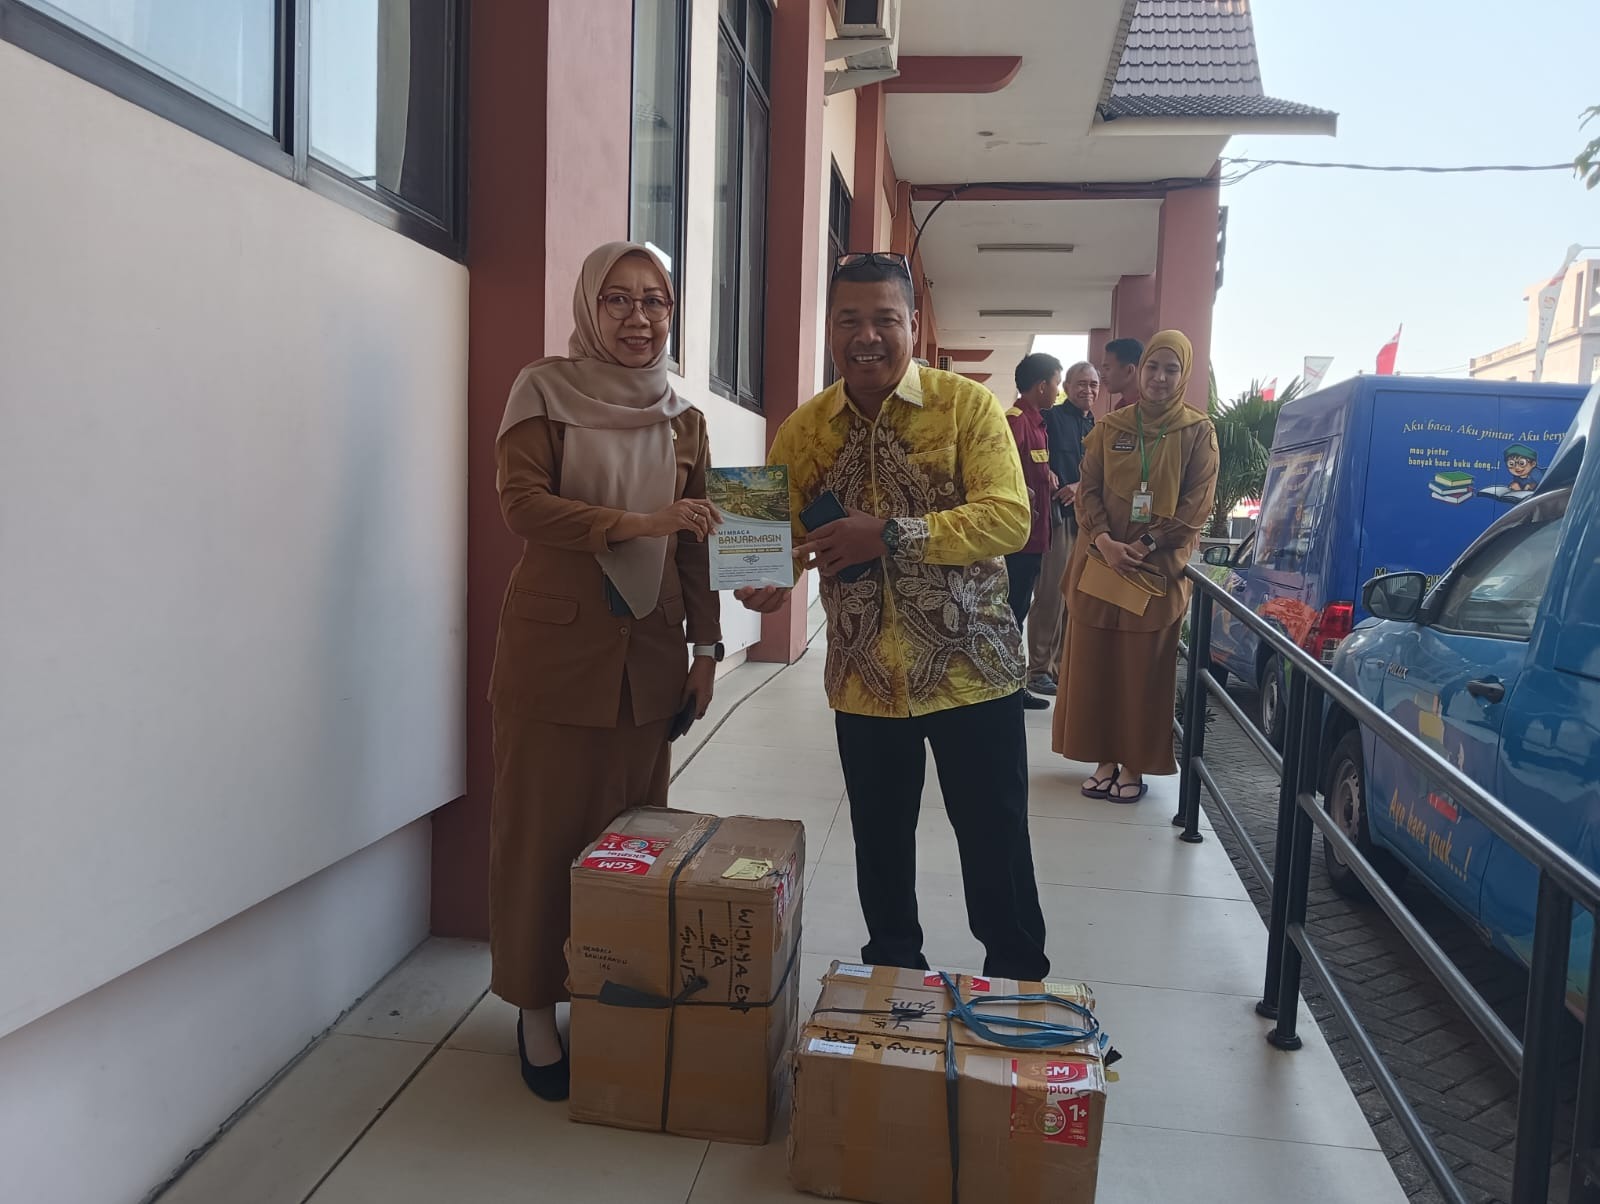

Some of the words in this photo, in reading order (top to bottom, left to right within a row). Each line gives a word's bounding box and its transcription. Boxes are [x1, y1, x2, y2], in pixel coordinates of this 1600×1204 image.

[1402, 420, 1424, 433] Aku
[1457, 424, 1478, 436] Aku
[1519, 430, 1539, 441] Aku
[1426, 447, 1449, 457] pintar
[1408, 457, 1433, 467] banyak
[1434, 458, 1451, 467] baca
[1453, 459, 1471, 468] buku
[718, 534, 782, 544] BANJARMASIN
[1389, 788, 1406, 832] Ayo
[598, 860, 636, 870] SGM
[1030, 1065, 1070, 1077] SGM
[1068, 1104, 1087, 1122] 1+
